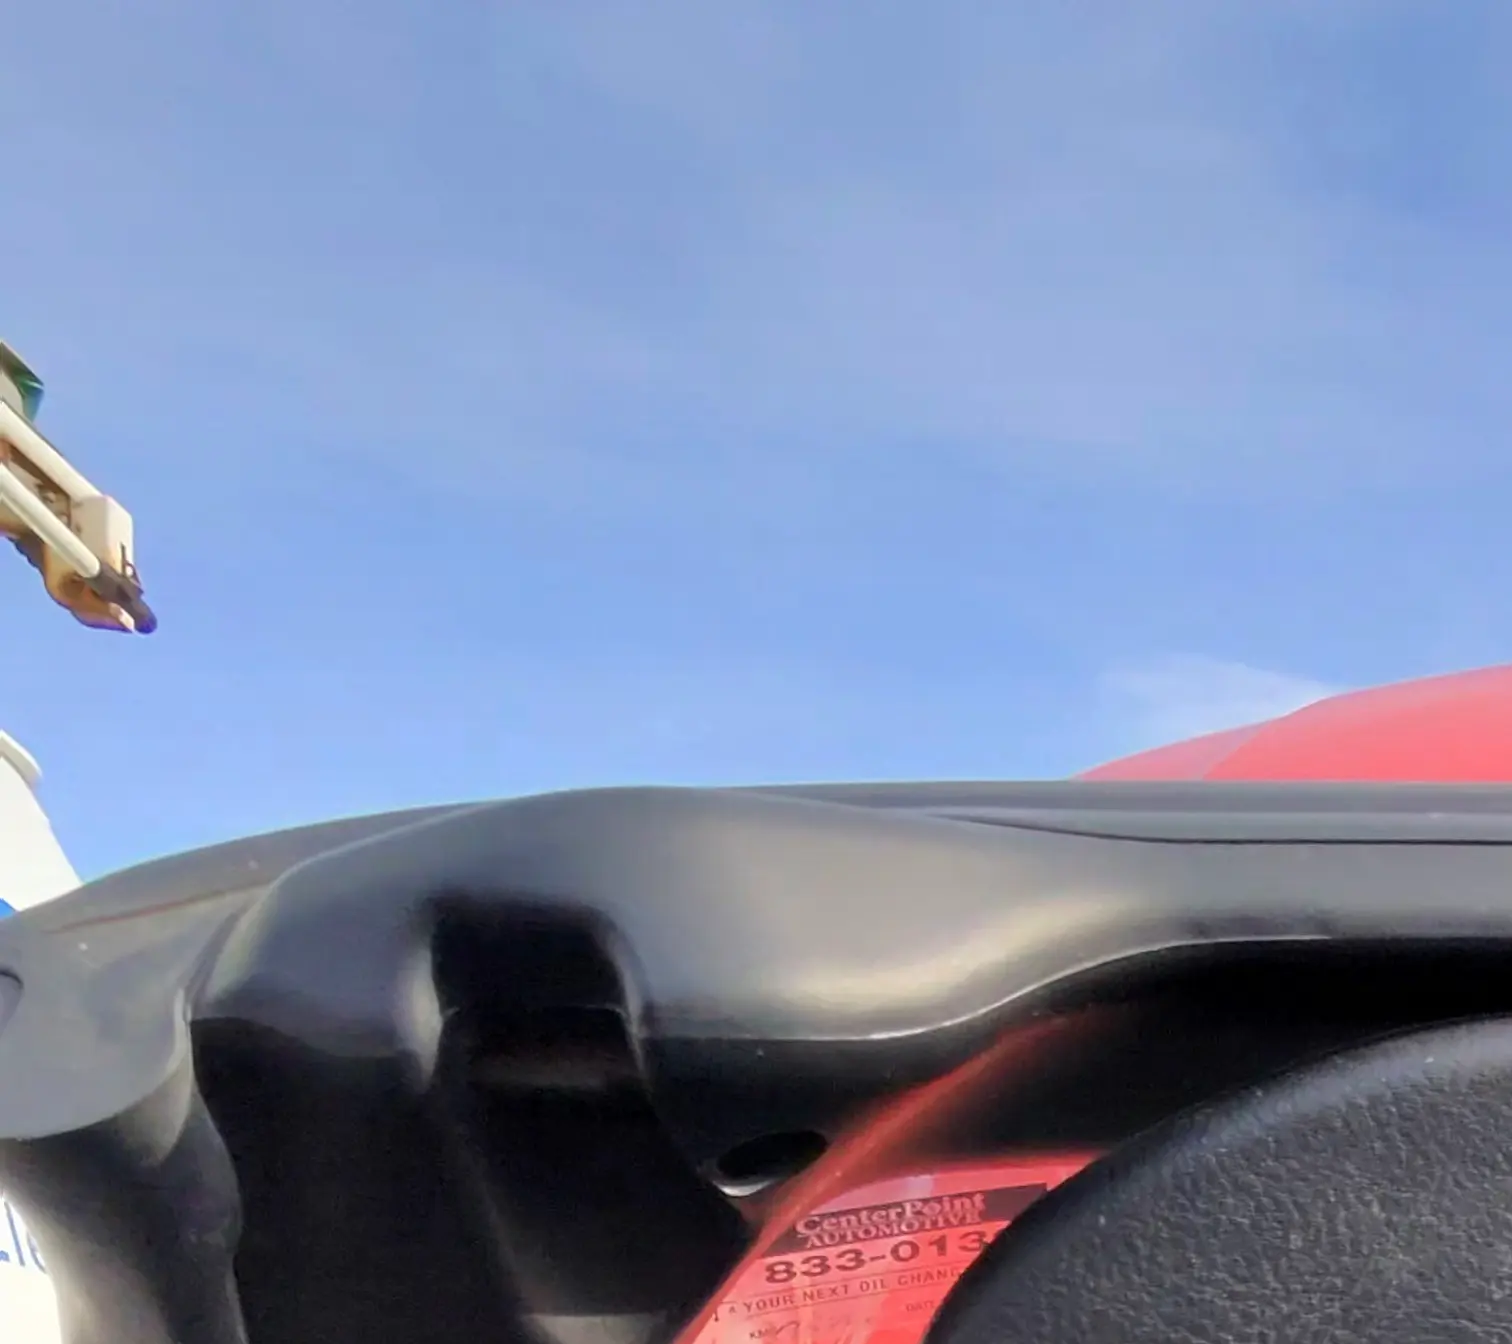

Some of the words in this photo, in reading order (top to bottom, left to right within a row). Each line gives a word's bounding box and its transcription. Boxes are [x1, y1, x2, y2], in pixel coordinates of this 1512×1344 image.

[805, 1211, 983, 1249] AUTOMOTIVE
[764, 1230, 990, 1284] 833-013
[743, 1295, 795, 1313] YOUR
[803, 1284, 850, 1303] NEXT
[859, 1278, 887, 1293] OIL
